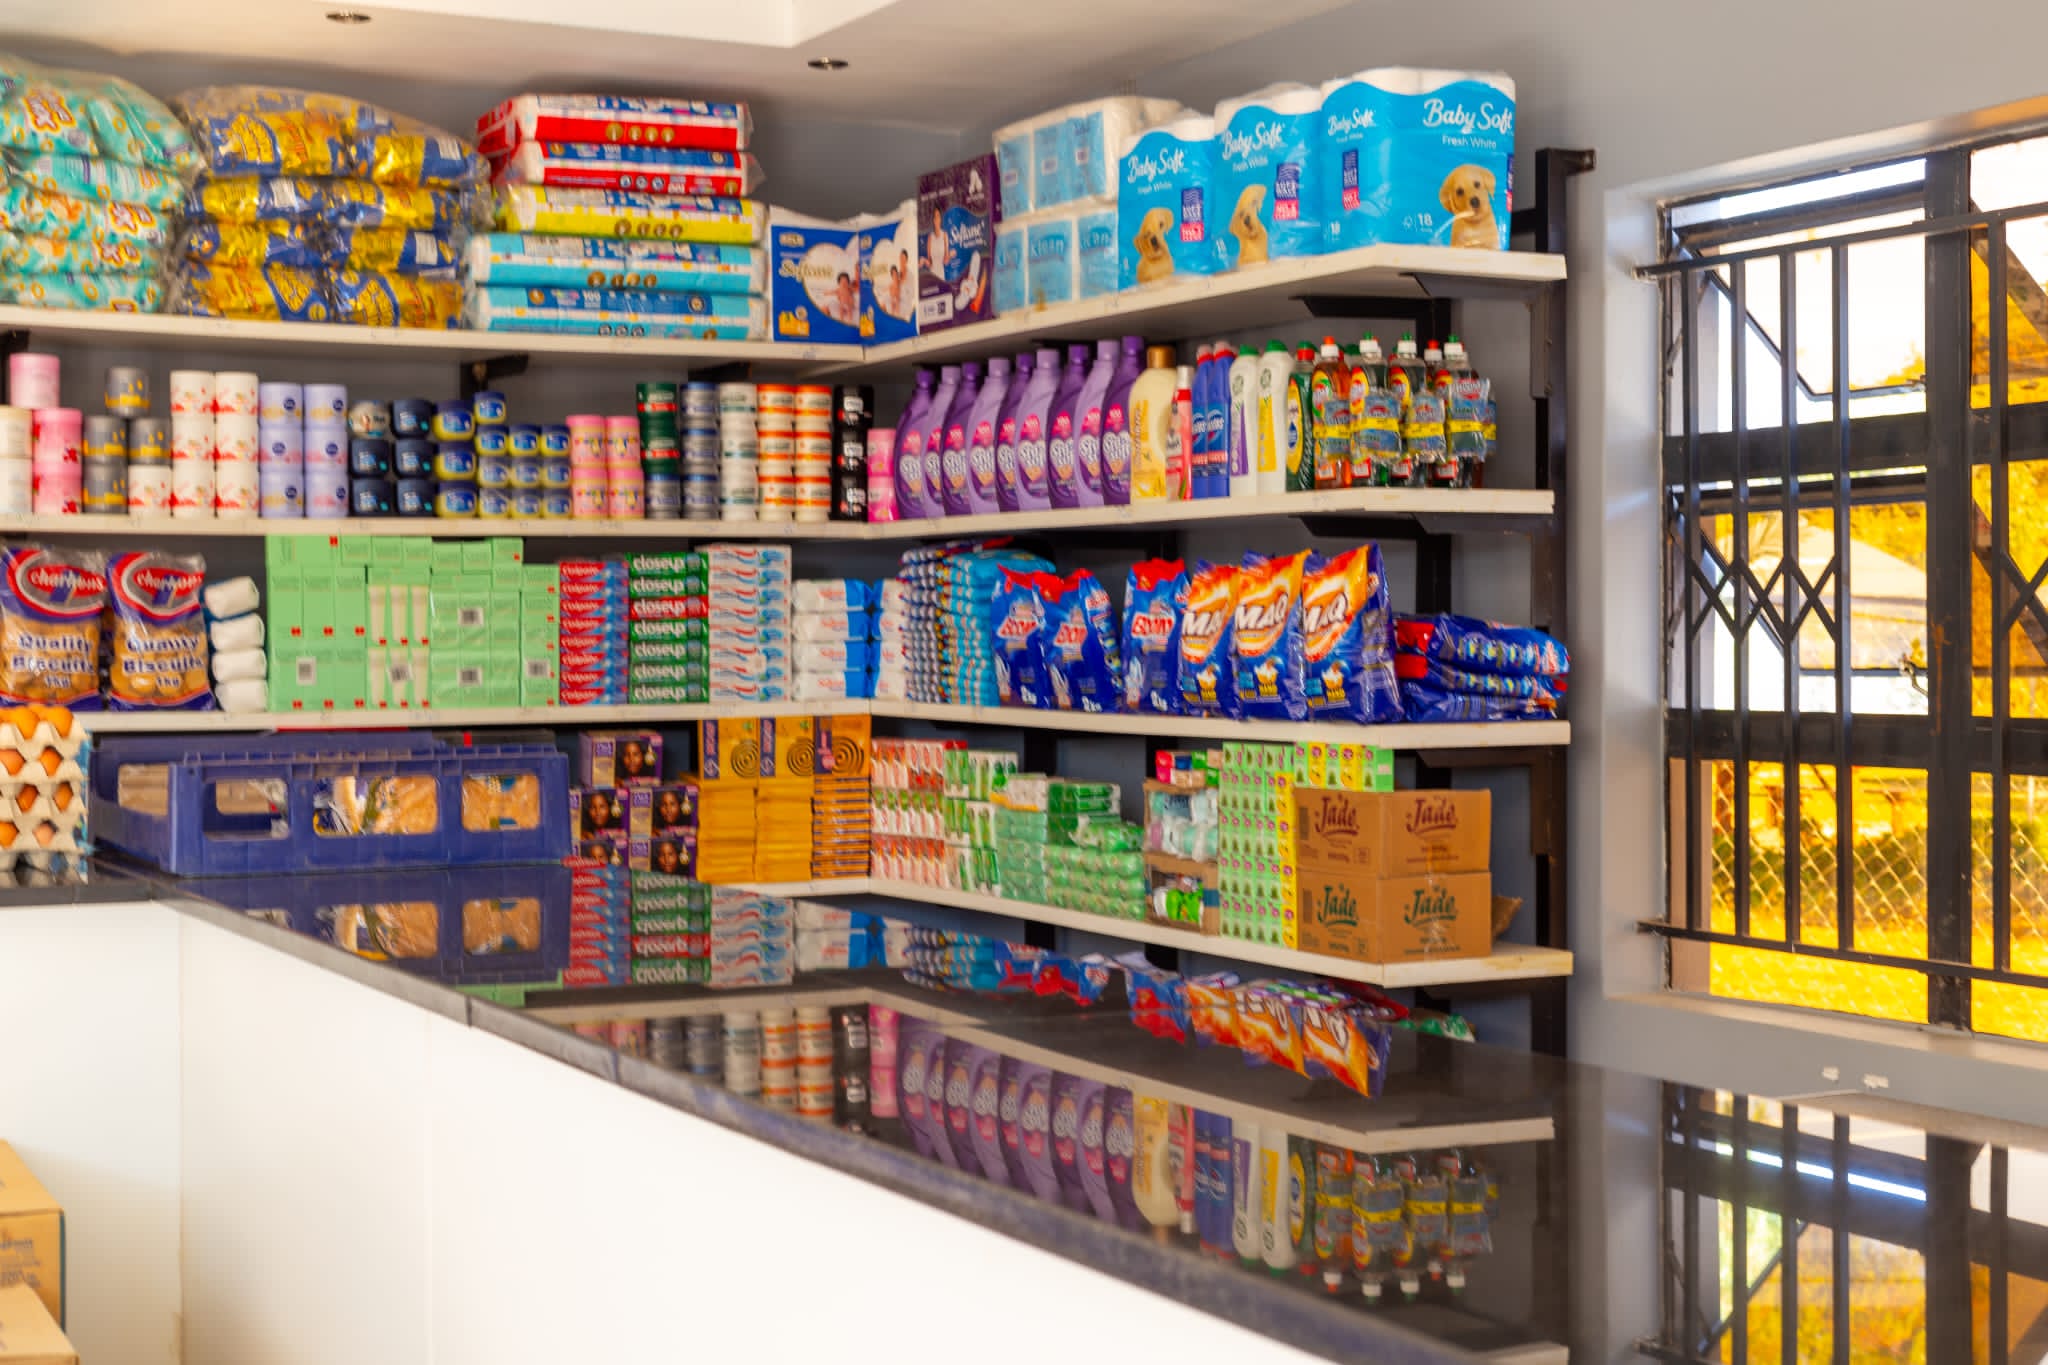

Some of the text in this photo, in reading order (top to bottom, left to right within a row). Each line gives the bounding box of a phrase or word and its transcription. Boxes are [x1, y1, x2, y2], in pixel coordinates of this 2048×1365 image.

[1328, 107, 1374, 136] Baby Soft
[1423, 98, 1513, 135] Baby Soft
[1222, 120, 1282, 161] Baby Soft
[1442, 134, 1497, 149] Fresh White
[1127, 147, 1184, 183] Baby Soft
[1418, 213, 1433, 227] 18
[633, 555, 685, 573] closeup
[633, 577, 684, 594] closeup
[633, 599, 684, 617] closeup
[1234, 594, 1289, 631] MAQ
[634, 620, 686, 638] closeup
[19, 635, 92, 653] Quality
[634, 642, 686, 660] closeup
[13, 656, 94, 673] Biscuits
[123, 656, 203, 672] Biscuits
[634, 664, 686, 681] closeup
[634, 685, 686, 702] closeup
[1315, 794, 1358, 833] Jade
[1406, 796, 1456, 833] Jade
[1317, 884, 1358, 924] Jade
[1405, 886, 1456, 924] Jade
